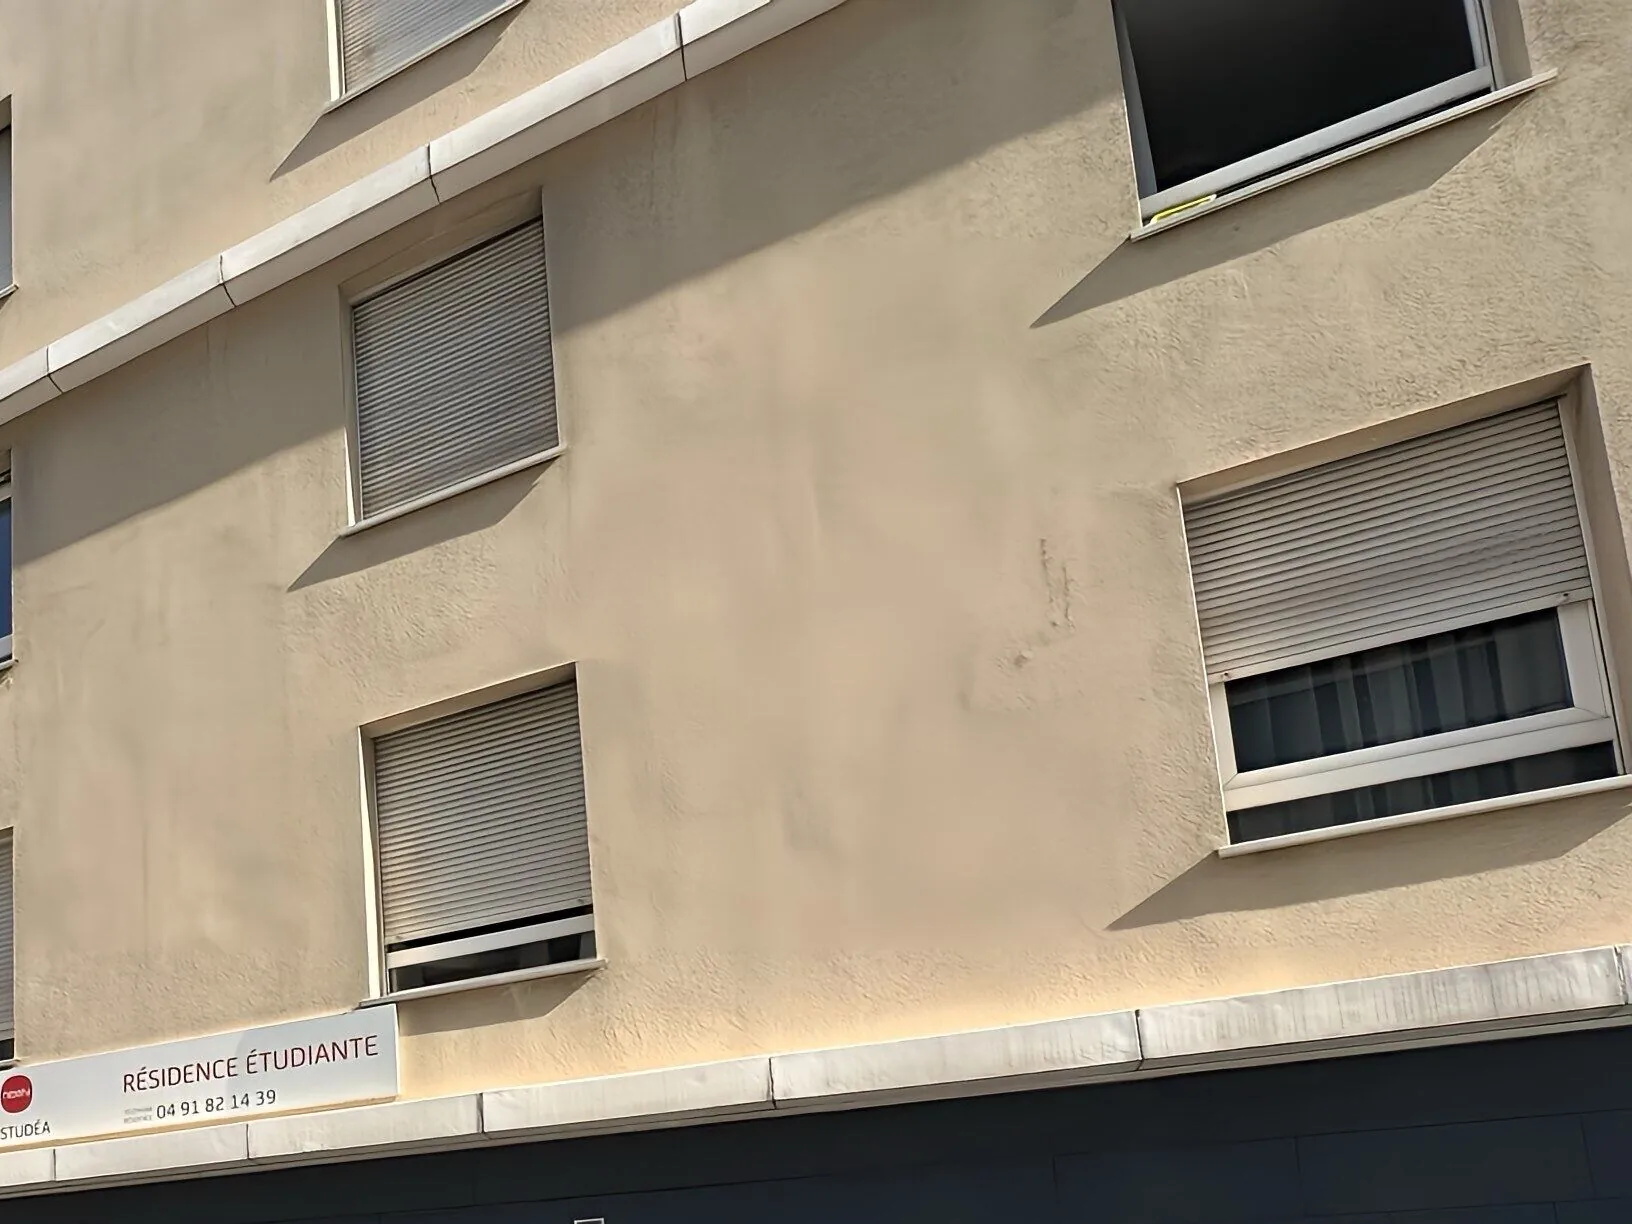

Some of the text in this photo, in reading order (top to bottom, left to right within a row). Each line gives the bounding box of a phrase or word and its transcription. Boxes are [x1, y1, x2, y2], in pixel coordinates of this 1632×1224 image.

[123, 1035, 379, 1093] RÉSIDENCE ÉTUDIANTE
[157, 1104, 175, 1119] 04
[181, 1101, 199, 1116] 91
[205, 1097, 224, 1112] 82
[231, 1094, 250, 1110] 14
[256, 1090, 277, 1106] 39
[0, 1120, 51, 1140] STUDÉA
